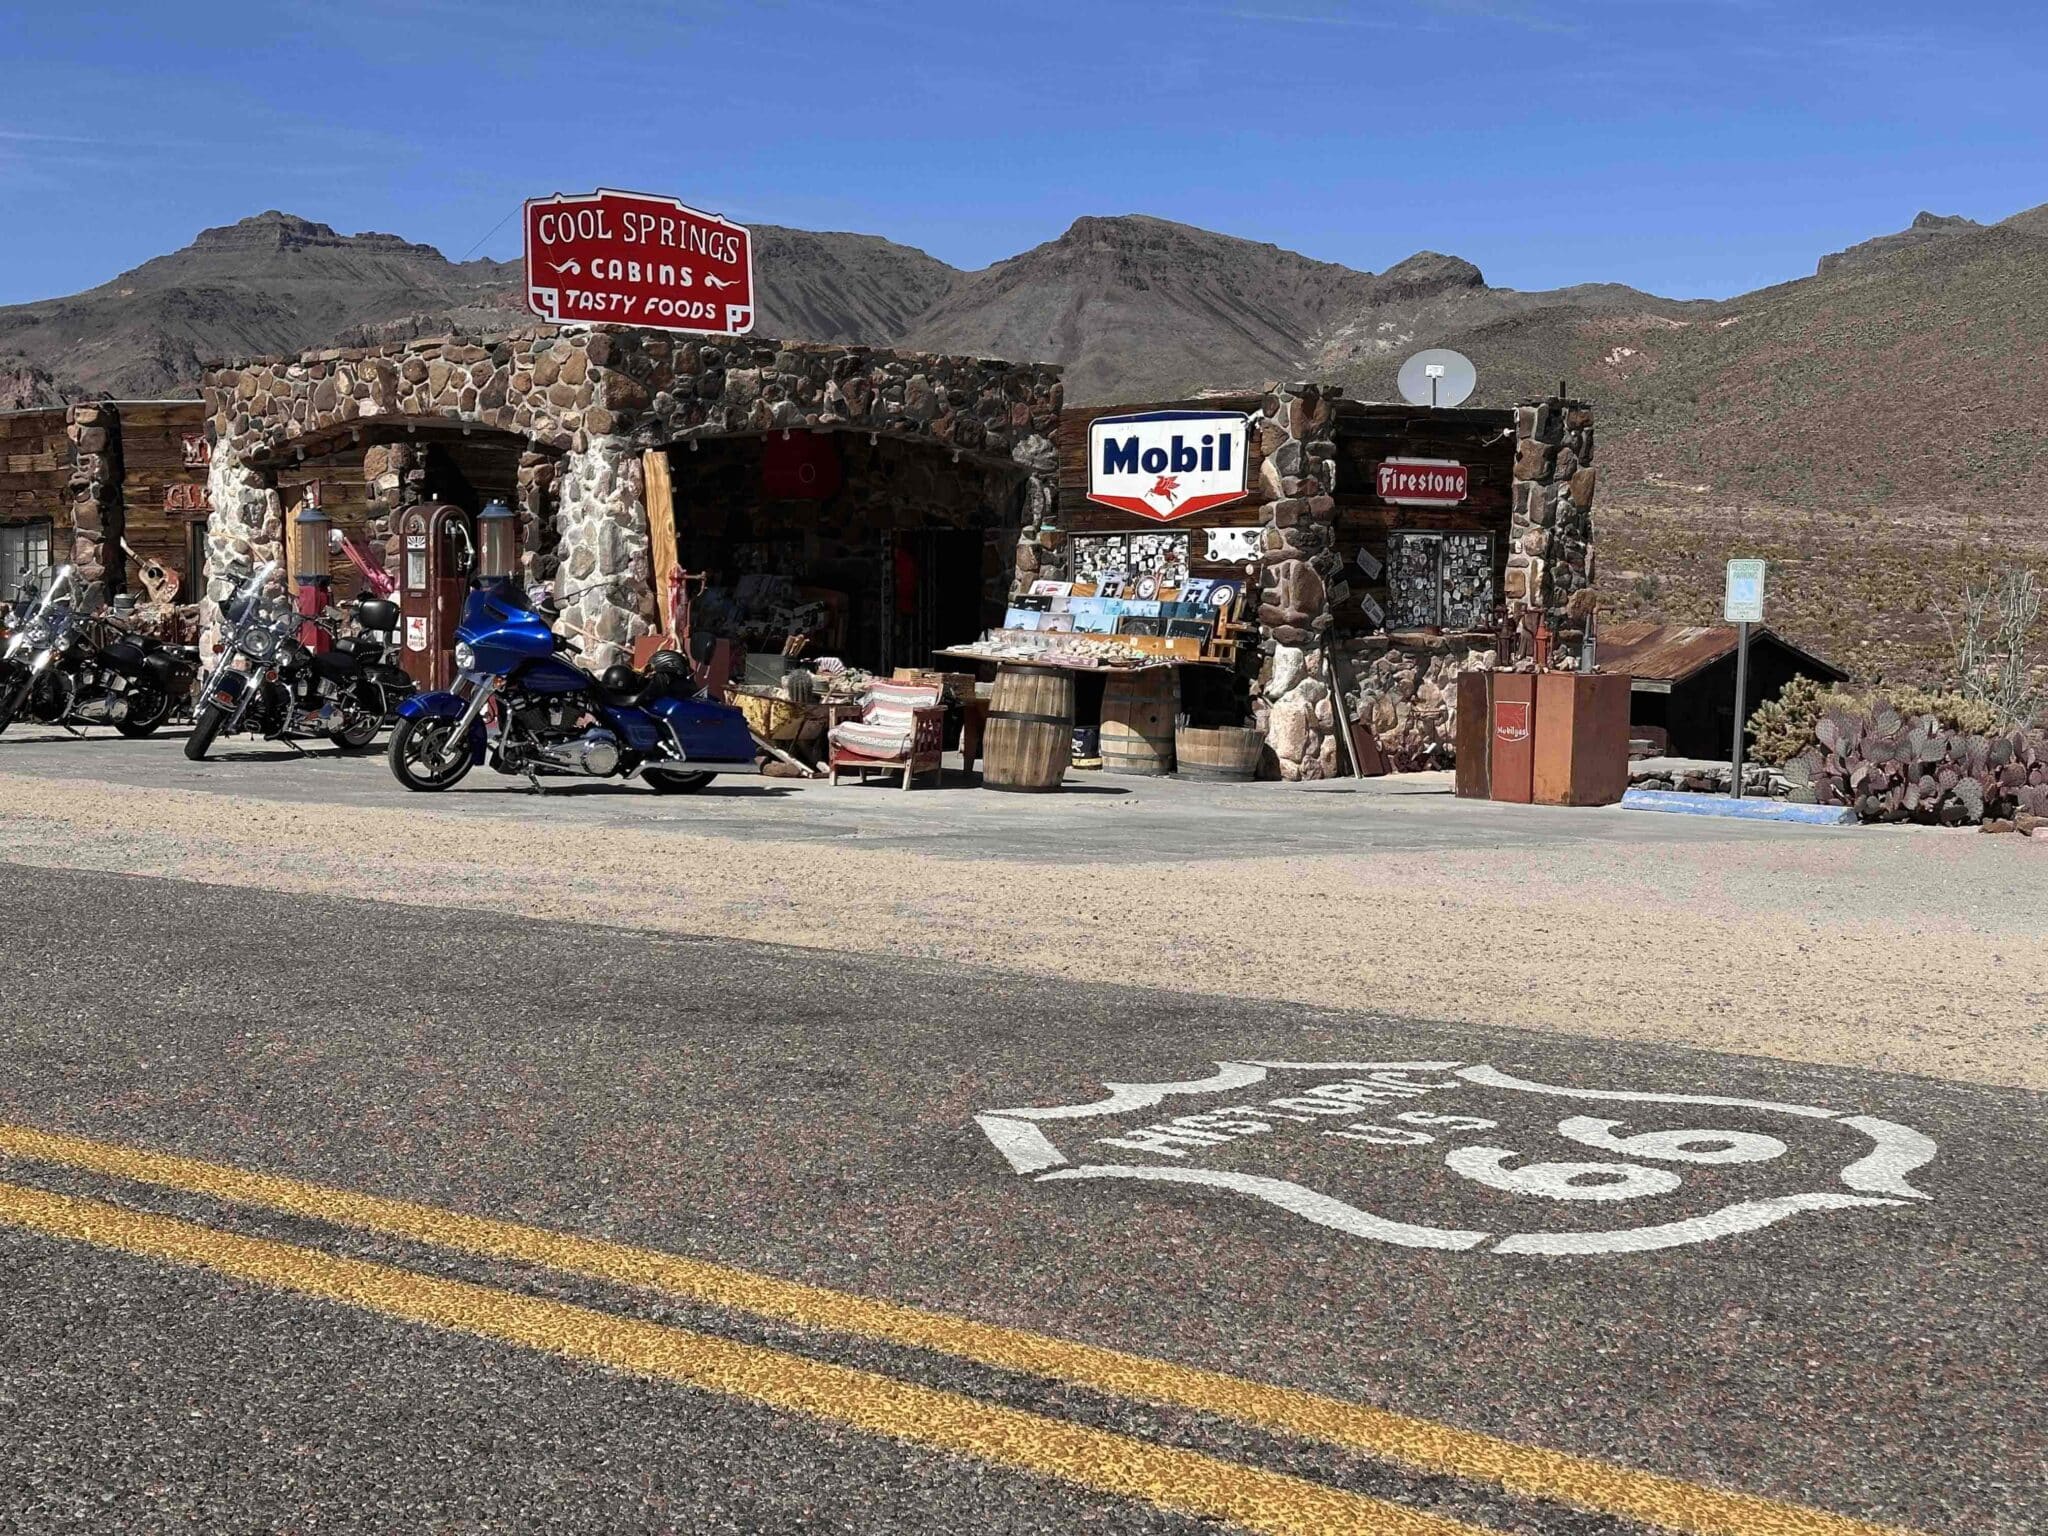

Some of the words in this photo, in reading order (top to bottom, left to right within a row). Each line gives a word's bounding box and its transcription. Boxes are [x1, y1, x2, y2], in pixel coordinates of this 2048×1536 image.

[539, 209, 612, 245] COOL
[623, 211, 740, 265] SPRINGS
[590, 258, 693, 287] CABINS
[565, 289, 637, 315] TASTY
[644, 297, 716, 320] FOODS
[1103, 433, 1231, 475] Mobil
[1379, 467, 1464, 494] Firestone
[1094, 1072, 1461, 1158] HISTORIC
[1322, 1111, 1498, 1146] US
[1445, 1115, 1787, 1201] 66
